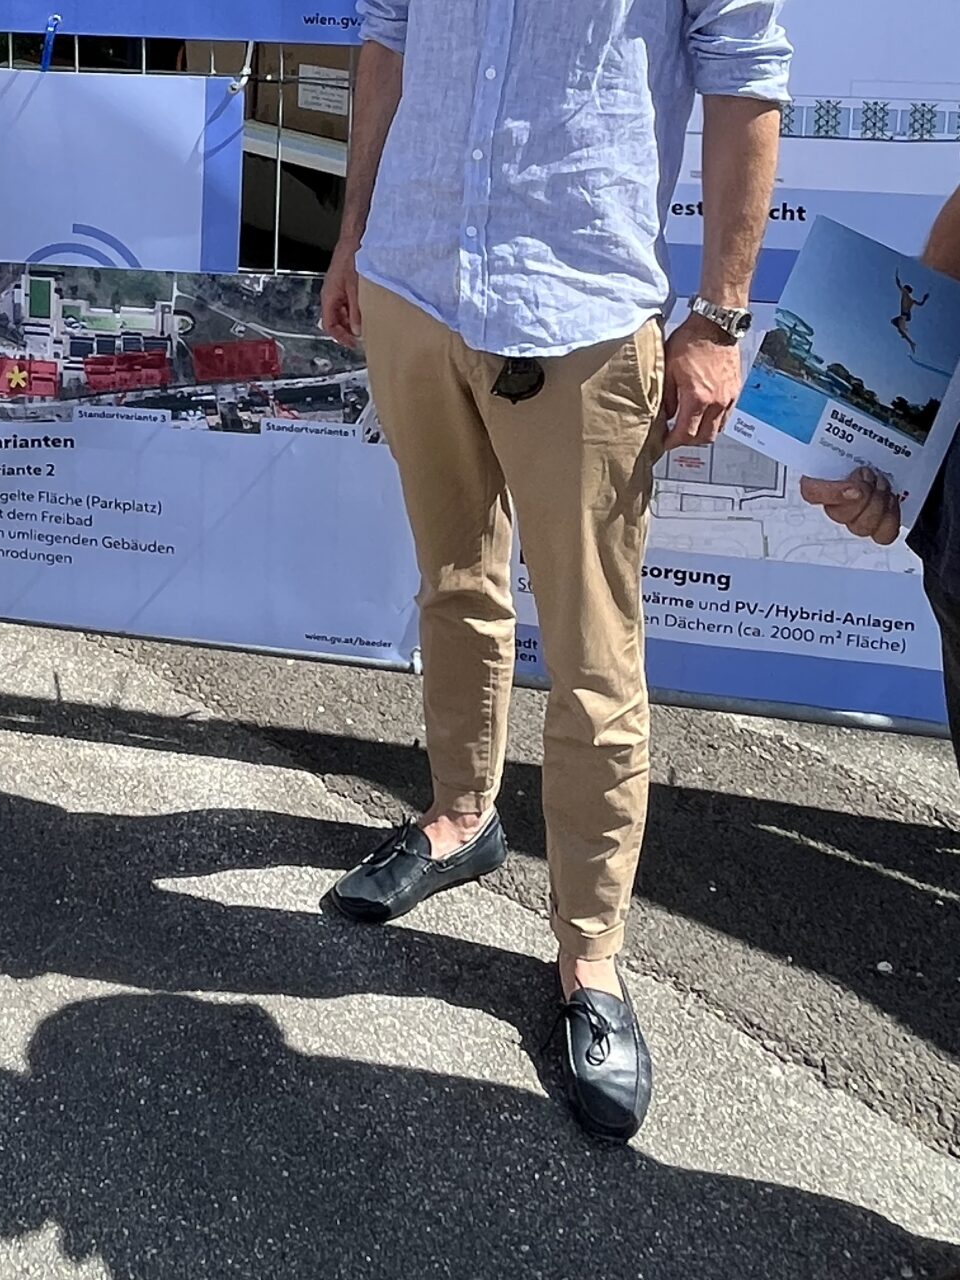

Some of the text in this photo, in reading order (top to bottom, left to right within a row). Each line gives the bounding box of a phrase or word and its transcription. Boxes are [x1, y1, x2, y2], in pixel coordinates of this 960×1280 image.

[78, 410, 167, 423] Standortvariante 3
[266, 422, 356, 438] Standortvariante 1
[824, 422, 854, 444] 2030
[830, 409, 912, 458] Bäderstrategie
[46, 464, 55, 477] 2
[38, 490, 83, 507] Fläche
[86, 494, 163, 515] (Parkplatz)
[7, 509, 38, 521] dem
[41, 511, 93, 527] Freibad
[8, 528, 98, 548] umliegenden
[101, 536, 175, 555] Gebäuden
[641, 565, 732, 591] sorgung
[698, 599, 730, 613] und
[735, 601, 916, 633] PV-/Hybrid-Anlagen
[305, 632, 393, 649] wien.gv.at/baeder
[664, 614, 733, 635] Dächern
[737, 622, 765, 639] (ca.
[770, 625, 815, 643] 2000
[846, 633, 907, 654] Fläche)
